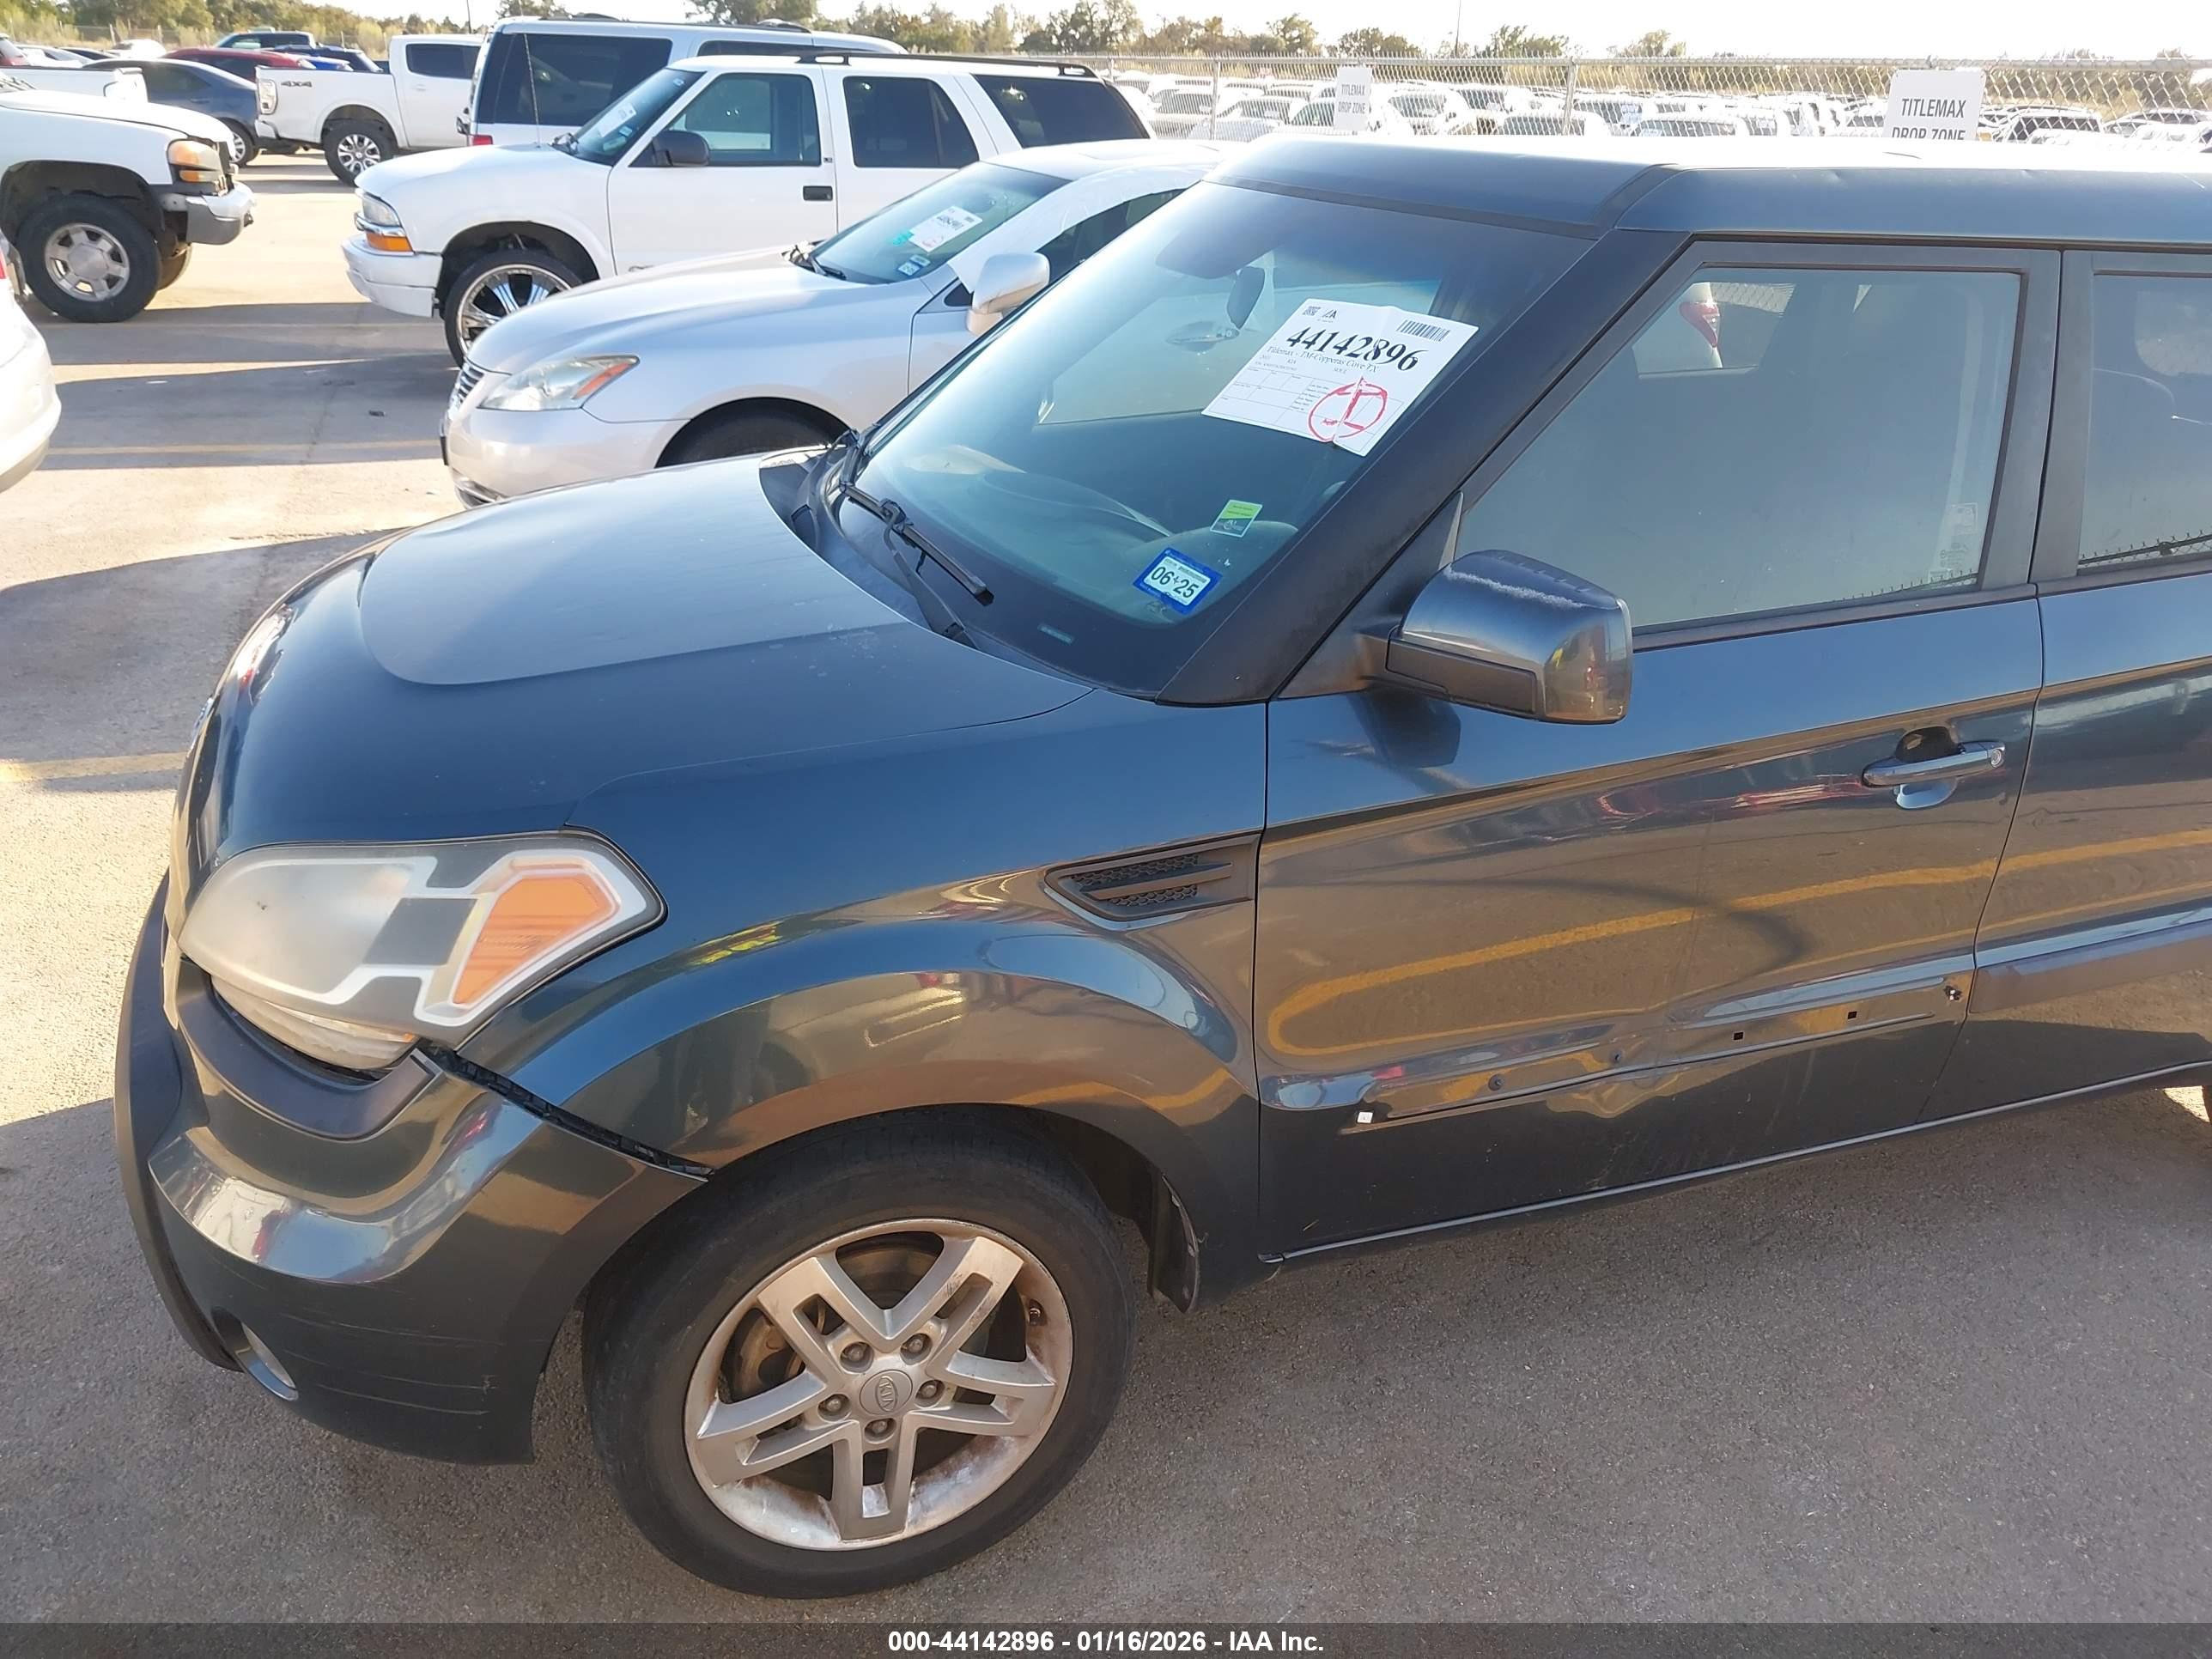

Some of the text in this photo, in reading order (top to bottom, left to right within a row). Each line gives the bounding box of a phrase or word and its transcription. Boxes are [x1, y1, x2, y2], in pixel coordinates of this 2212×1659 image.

[1341, 83, 1365, 96] TITLEMAX
[1338, 101, 1366, 114] DROP ZONE
[1901, 98, 1966, 118] TITLEMAX
[1286, 326, 1429, 371] 44142896
